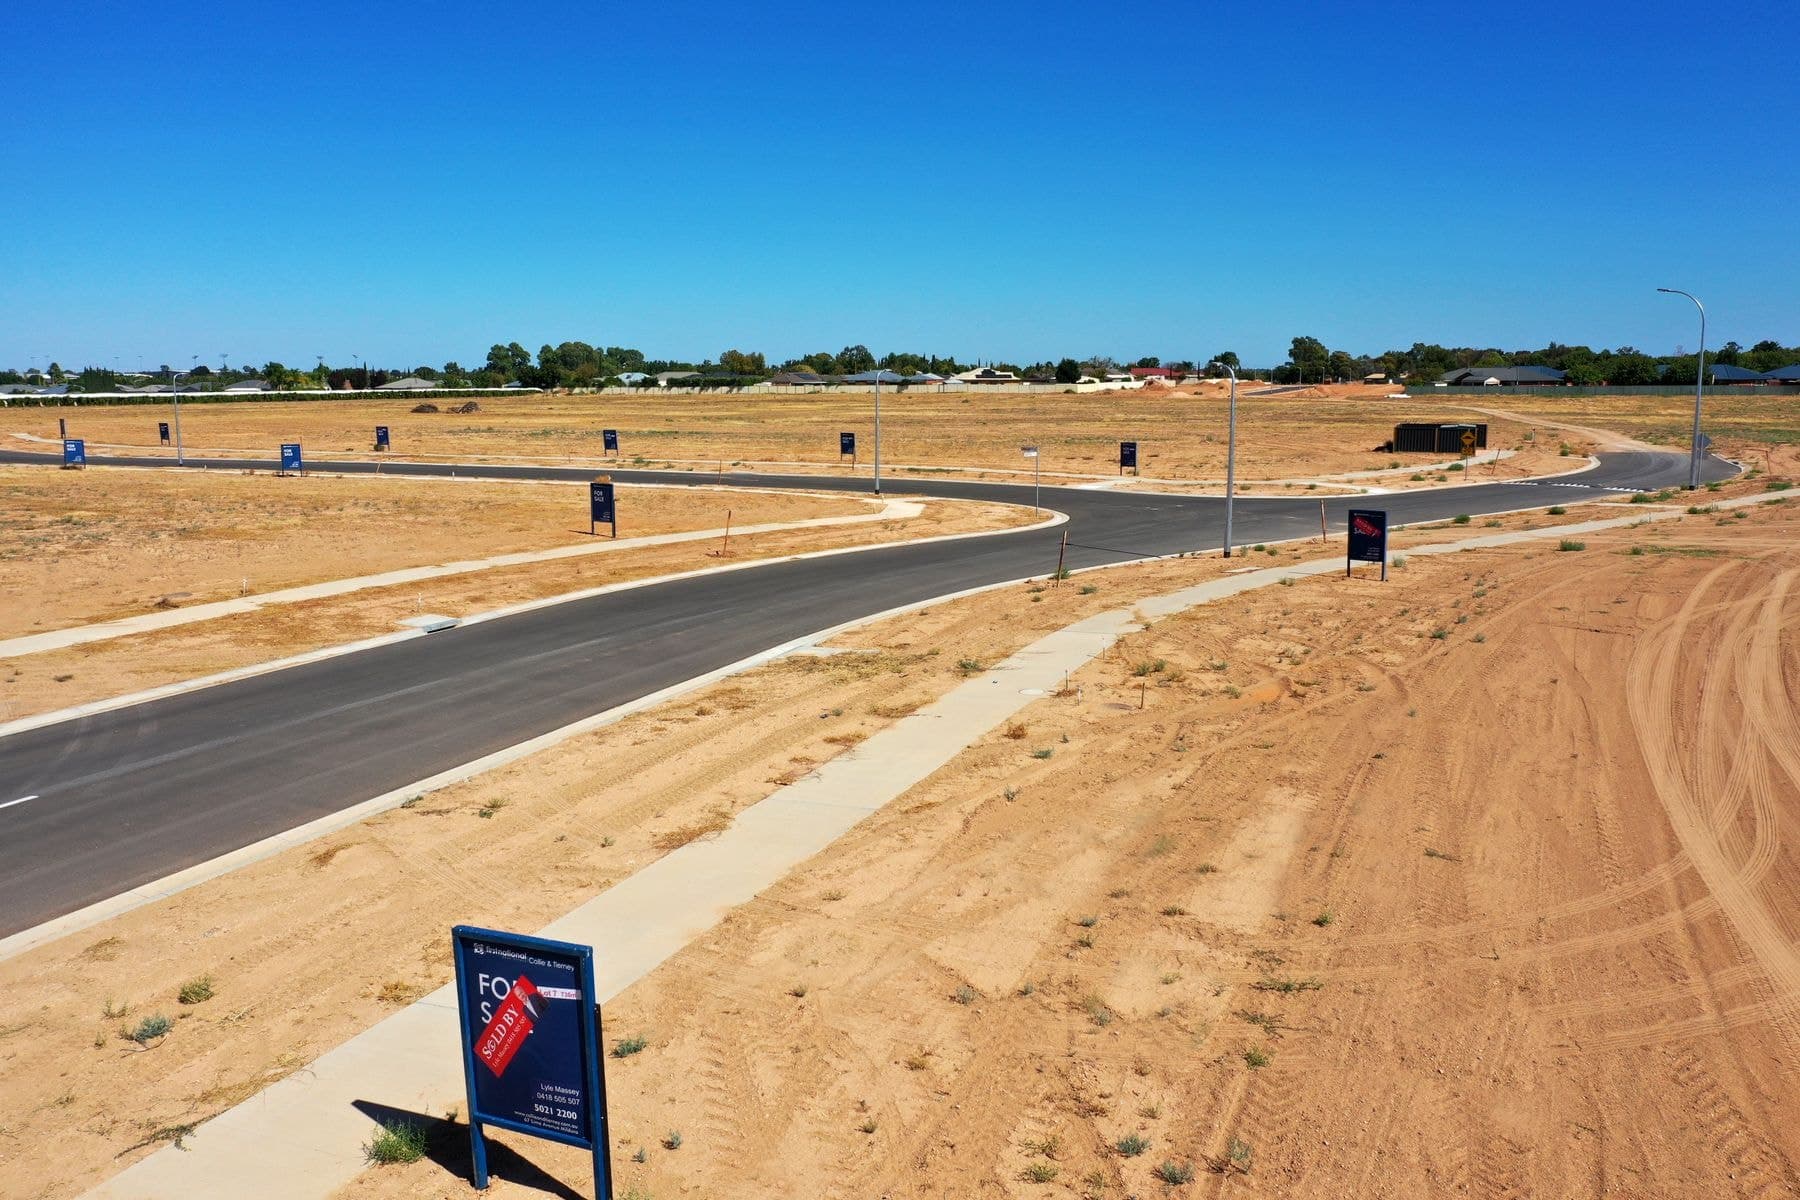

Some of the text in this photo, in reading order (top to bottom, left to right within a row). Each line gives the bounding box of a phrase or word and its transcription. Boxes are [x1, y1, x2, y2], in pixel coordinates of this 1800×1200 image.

[553, 961, 575, 972] Tierney
[479, 973, 516, 1000] FO
[482, 1024, 507, 1059] SOLD
[502, 1004, 519, 1026] BY
[541, 1083, 580, 1097] Lyle Massey
[536, 1092, 580, 1105] 0418 505 507
[534, 1103, 577, 1120] 5021 2200
